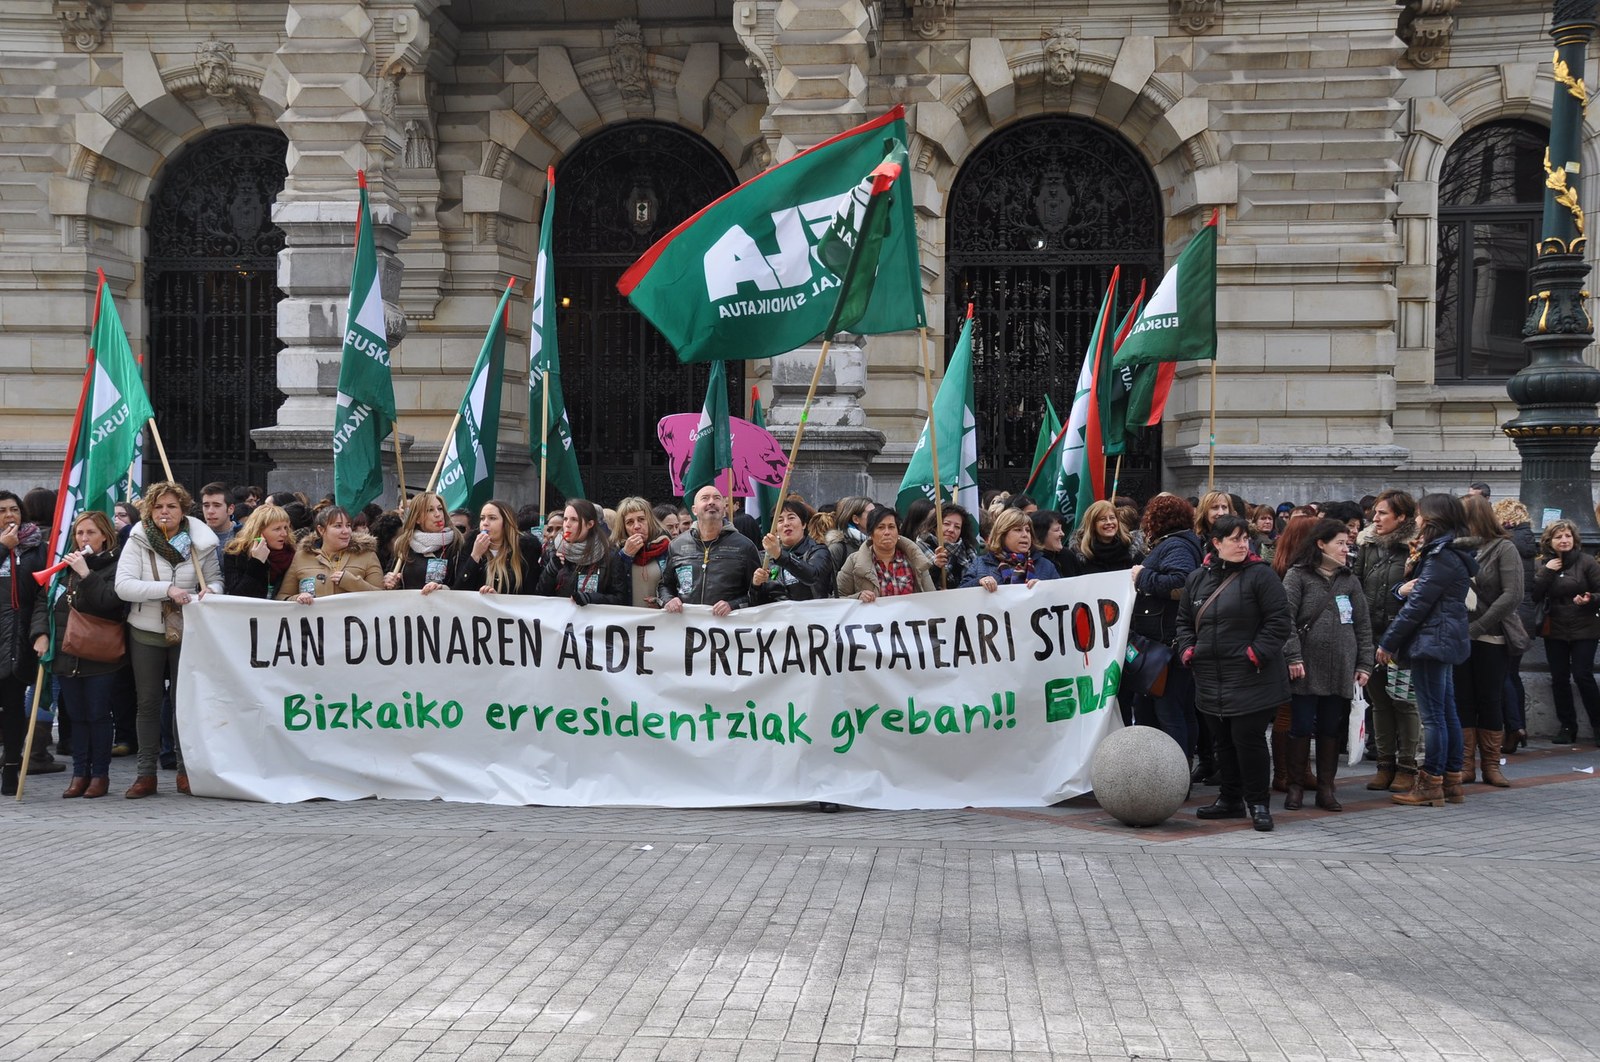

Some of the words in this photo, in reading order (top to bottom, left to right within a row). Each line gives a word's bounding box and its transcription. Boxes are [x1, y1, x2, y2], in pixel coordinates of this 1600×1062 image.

[249, 616, 325, 669] LAN
[344, 615, 542, 668] DUINAREN
[557, 622, 655, 676] ALDE
[684, 611, 1016, 677] PREKARIETATEARI
[1030, 598, 1120, 662] STOP
[283, 692, 465, 732] Bizkaiko
[485, 697, 813, 746] erresidentziak
[830, 690, 1017, 754] greban!!
[1045, 659, 1121, 724] ELA
